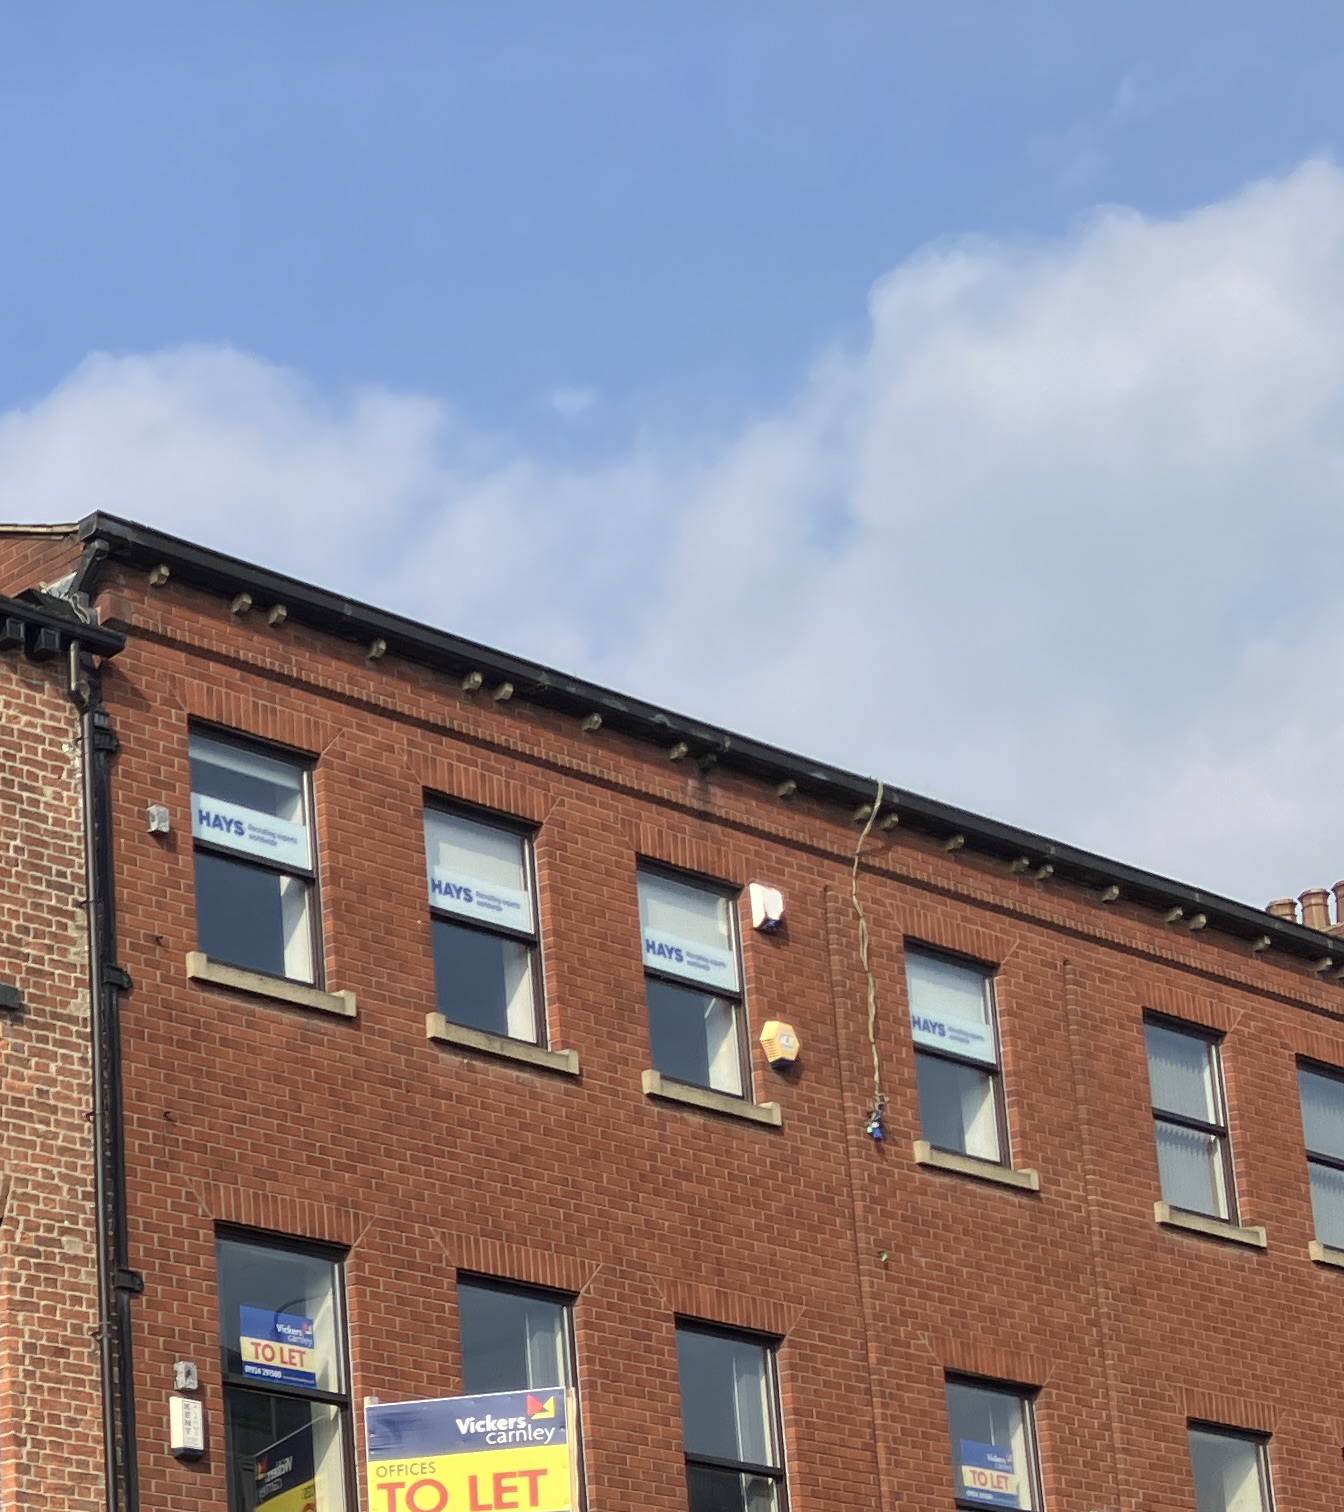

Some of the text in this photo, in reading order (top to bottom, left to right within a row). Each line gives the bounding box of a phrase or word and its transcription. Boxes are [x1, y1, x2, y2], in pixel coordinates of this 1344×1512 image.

[198, 809, 245, 836] HAYS
[431, 878, 473, 903] HAYS
[645, 939, 684, 963] HAYS
[912, 1015, 946, 1037] HAYS
[251, 1342, 306, 1367] TO LET
[456, 1414, 526, 1434] Vickers
[486, 1424, 556, 1445] carnley
[376, 1461, 436, 1478] OFFICES
[969, 1469, 1009, 1491] TO LET
[468, 1469, 548, 1512] LET
